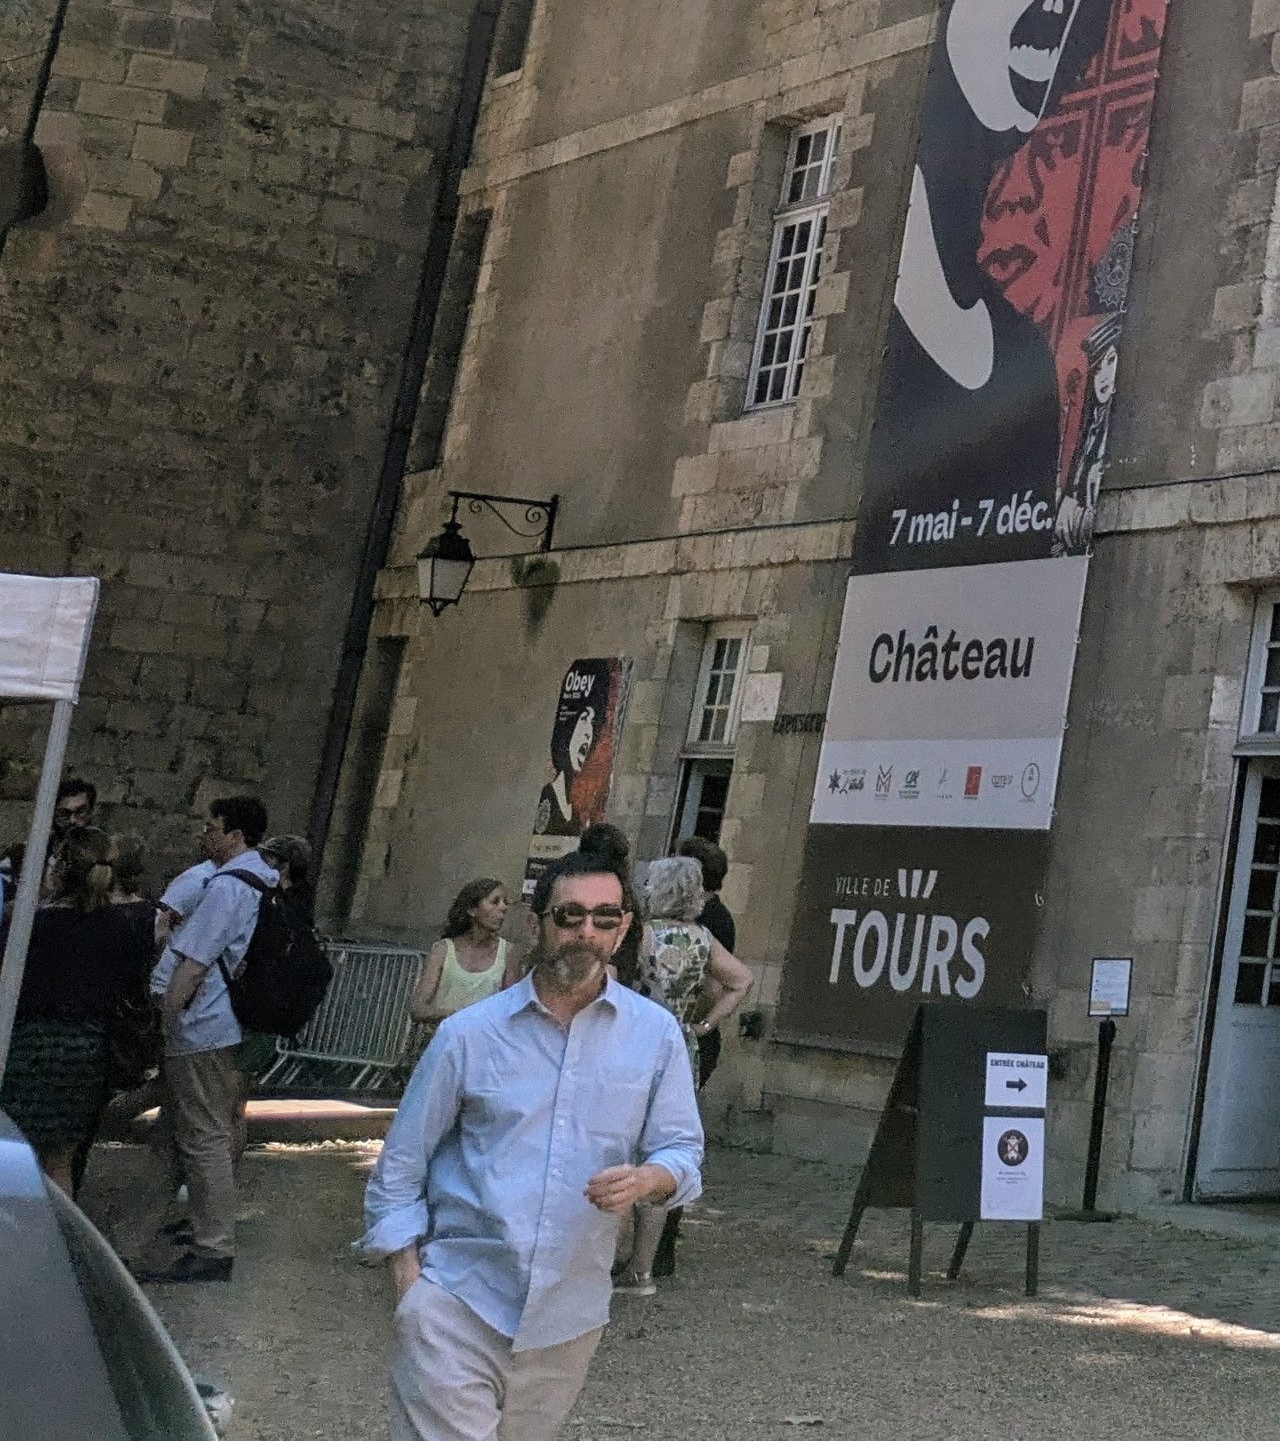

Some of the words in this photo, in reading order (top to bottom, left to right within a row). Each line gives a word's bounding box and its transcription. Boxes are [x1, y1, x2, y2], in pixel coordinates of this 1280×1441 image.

[889, 509, 907, 545] 7
[907, 498, 960, 544] mai
[977, 499, 995, 536] 7
[996, 490, 1052, 535] déc.
[869, 625, 1035, 683] Château
[565, 670, 596, 698] Obey
[835, 876, 871, 896] VILLE
[873, 878, 891, 897] DE
[829, 908, 991, 999] TOURS
[990, 1058, 1015, 1069] ENTRÉE
[1016, 1058, 1045, 1070] CHÂTEAU
